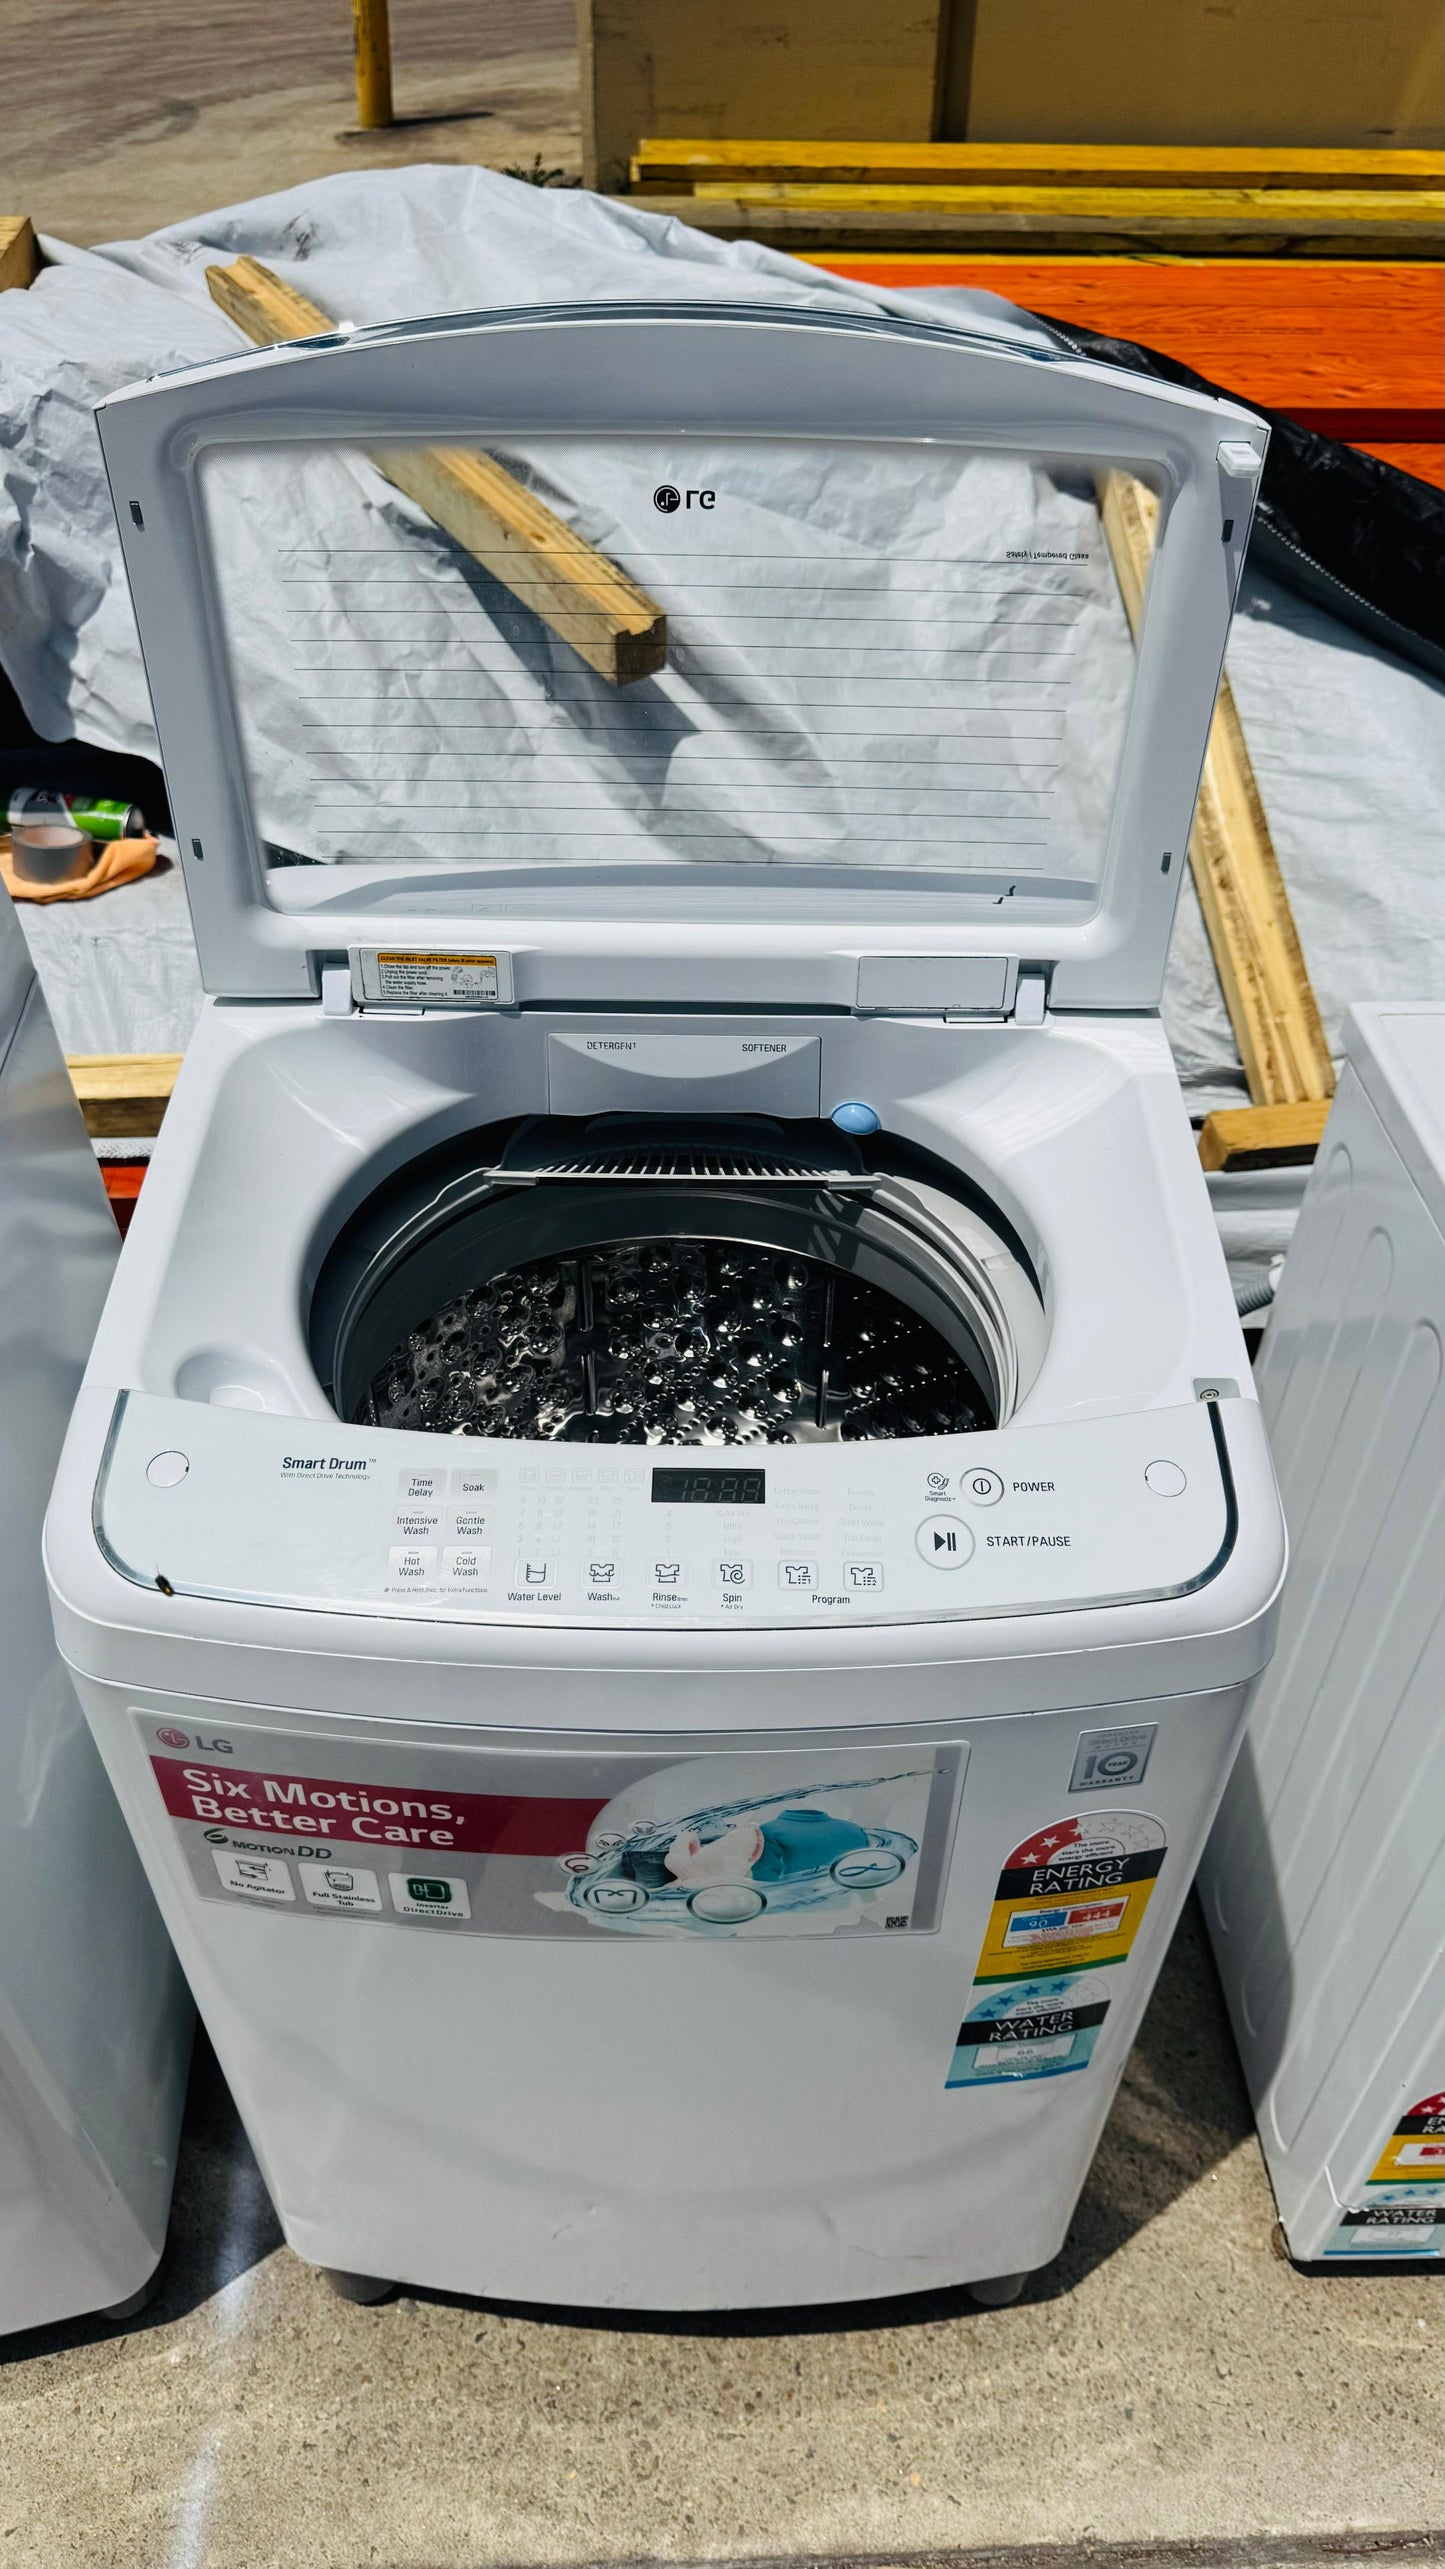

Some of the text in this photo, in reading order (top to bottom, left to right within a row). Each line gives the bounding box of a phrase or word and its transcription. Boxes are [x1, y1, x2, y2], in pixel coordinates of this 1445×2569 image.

[587, 1041, 787, 1053] DETERGENT SOFTENER
[282, 1457, 326, 1470] Smart
[335, 1473, 371, 1481] Technology
[412, 1478, 433, 1487] Time
[463, 1483, 485, 1492] Soak
[1012, 1482, 1055, 1492] POWER
[408, 1488, 434, 1498] Delay
[396, 1516, 438, 1525] Intensive
[456, 1516, 485, 1525] Gentle
[403, 1526, 429, 1535] Wash
[457, 1526, 483, 1535] Wash
[986, 1536, 1071, 1547] START/PAUSE
[404, 1557, 420, 1565] Hot
[456, 1557, 477, 1565] Cold
[398, 1568, 425, 1576] Wash
[452, 1568, 479, 1576] Wash
[508, 1592, 562, 1601] Water Level
[587, 1592, 613, 1601] Wash
[653, 1592, 677, 1601] Rinse
[723, 1593, 743, 1604] Spin
[812, 1594, 851, 1605] Program
[195, 1735, 234, 1754] LG
[1084, 1751, 1139, 1780] 10
[1079, 1776, 1135, 1786] WARRANTY
[182, 1769, 465, 1825] Six Motions,
[191, 1795, 455, 1846] Better Care
[232, 1840, 296, 1856] MOTION
[297, 1845, 332, 1859] DD
[1032, 1857, 1131, 1882] ENERGY
[230, 1880, 285, 1894] No Agitator
[1030, 1871, 1123, 1894] RATING
[313, 1891, 376, 1903] Full Stainless
[995, 2011, 1074, 2031] WATER
[989, 2021, 1074, 2042] RATING
[1374, 2209, 1436, 2217] WATER
